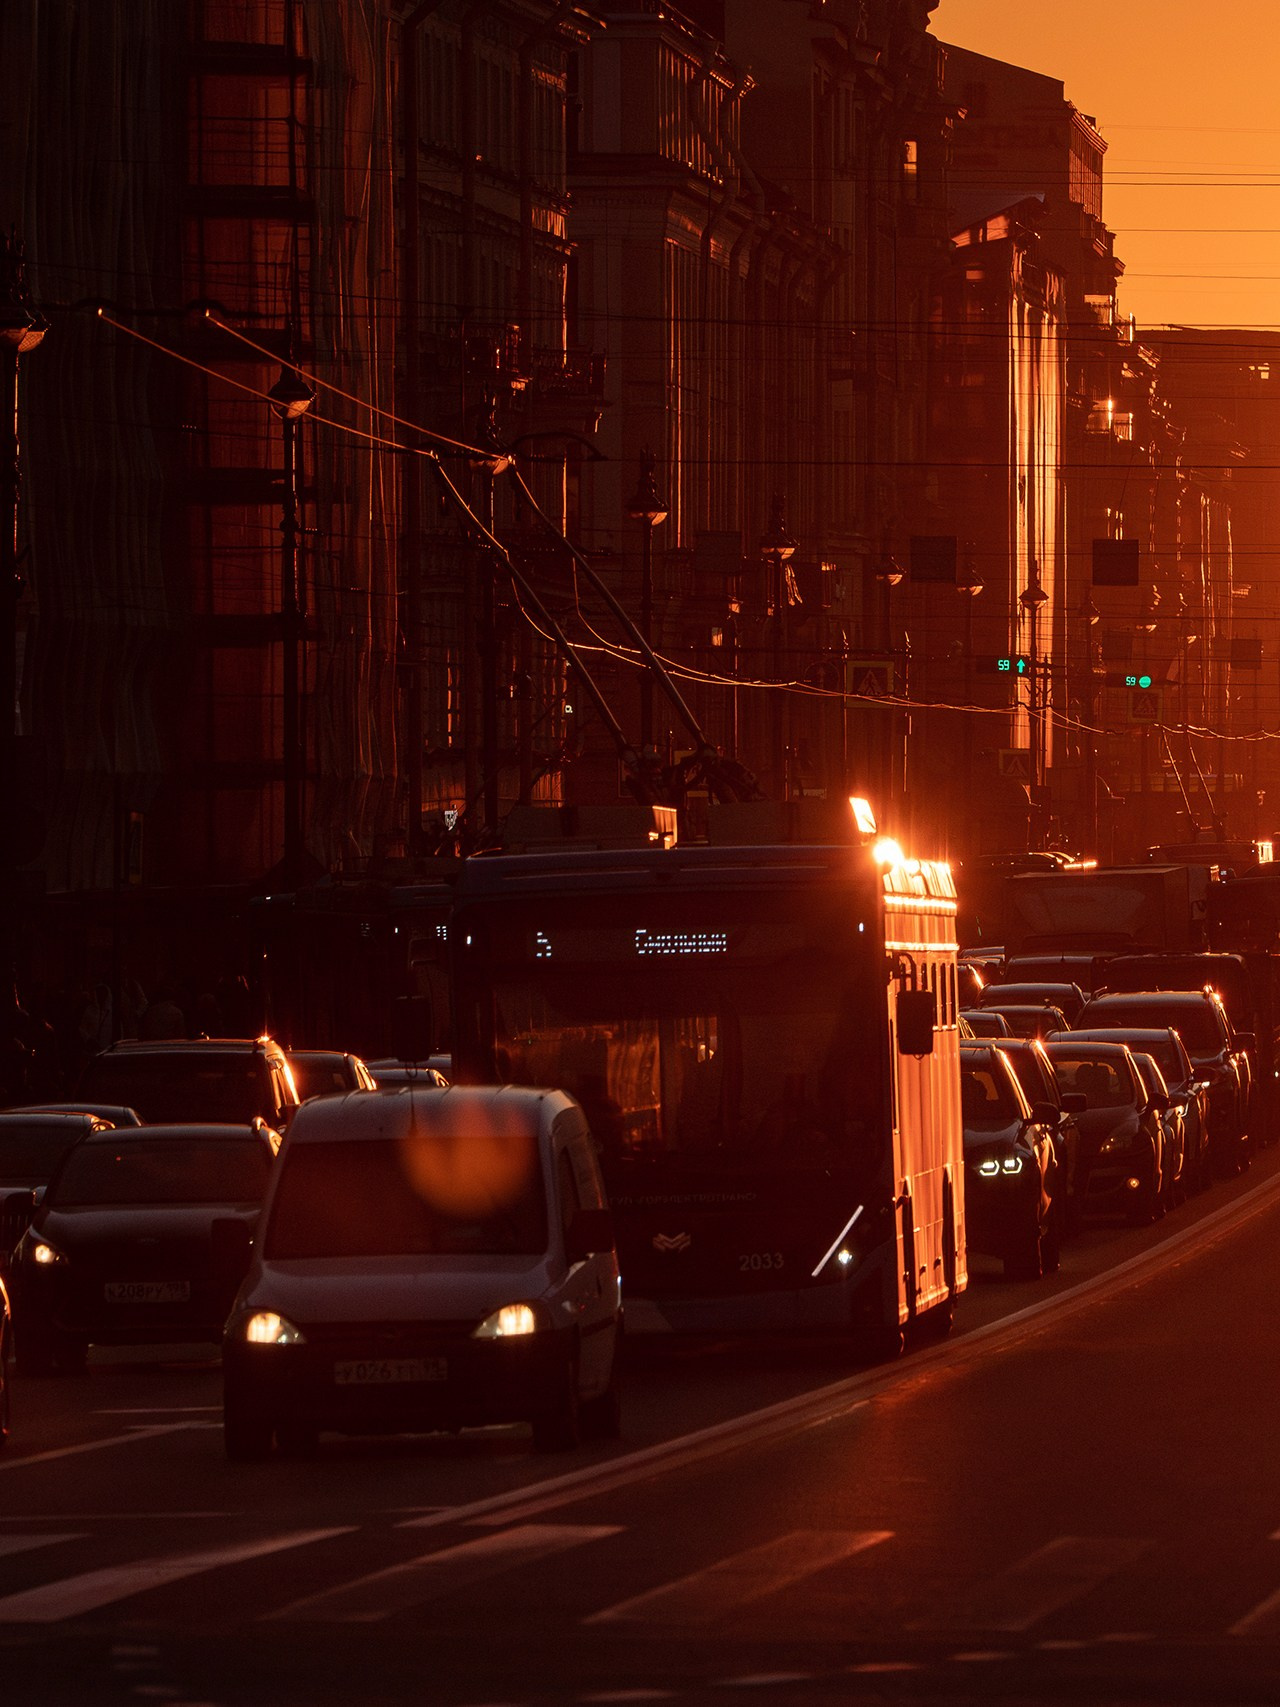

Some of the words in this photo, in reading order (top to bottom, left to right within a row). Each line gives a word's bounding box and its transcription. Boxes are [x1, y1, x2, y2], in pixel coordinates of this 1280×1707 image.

[997, 660, 1010, 671] 59
[1125, 676, 1137, 686] 59
[536, 932, 552, 957] 5
[738, 1252, 785, 1271] 2033
